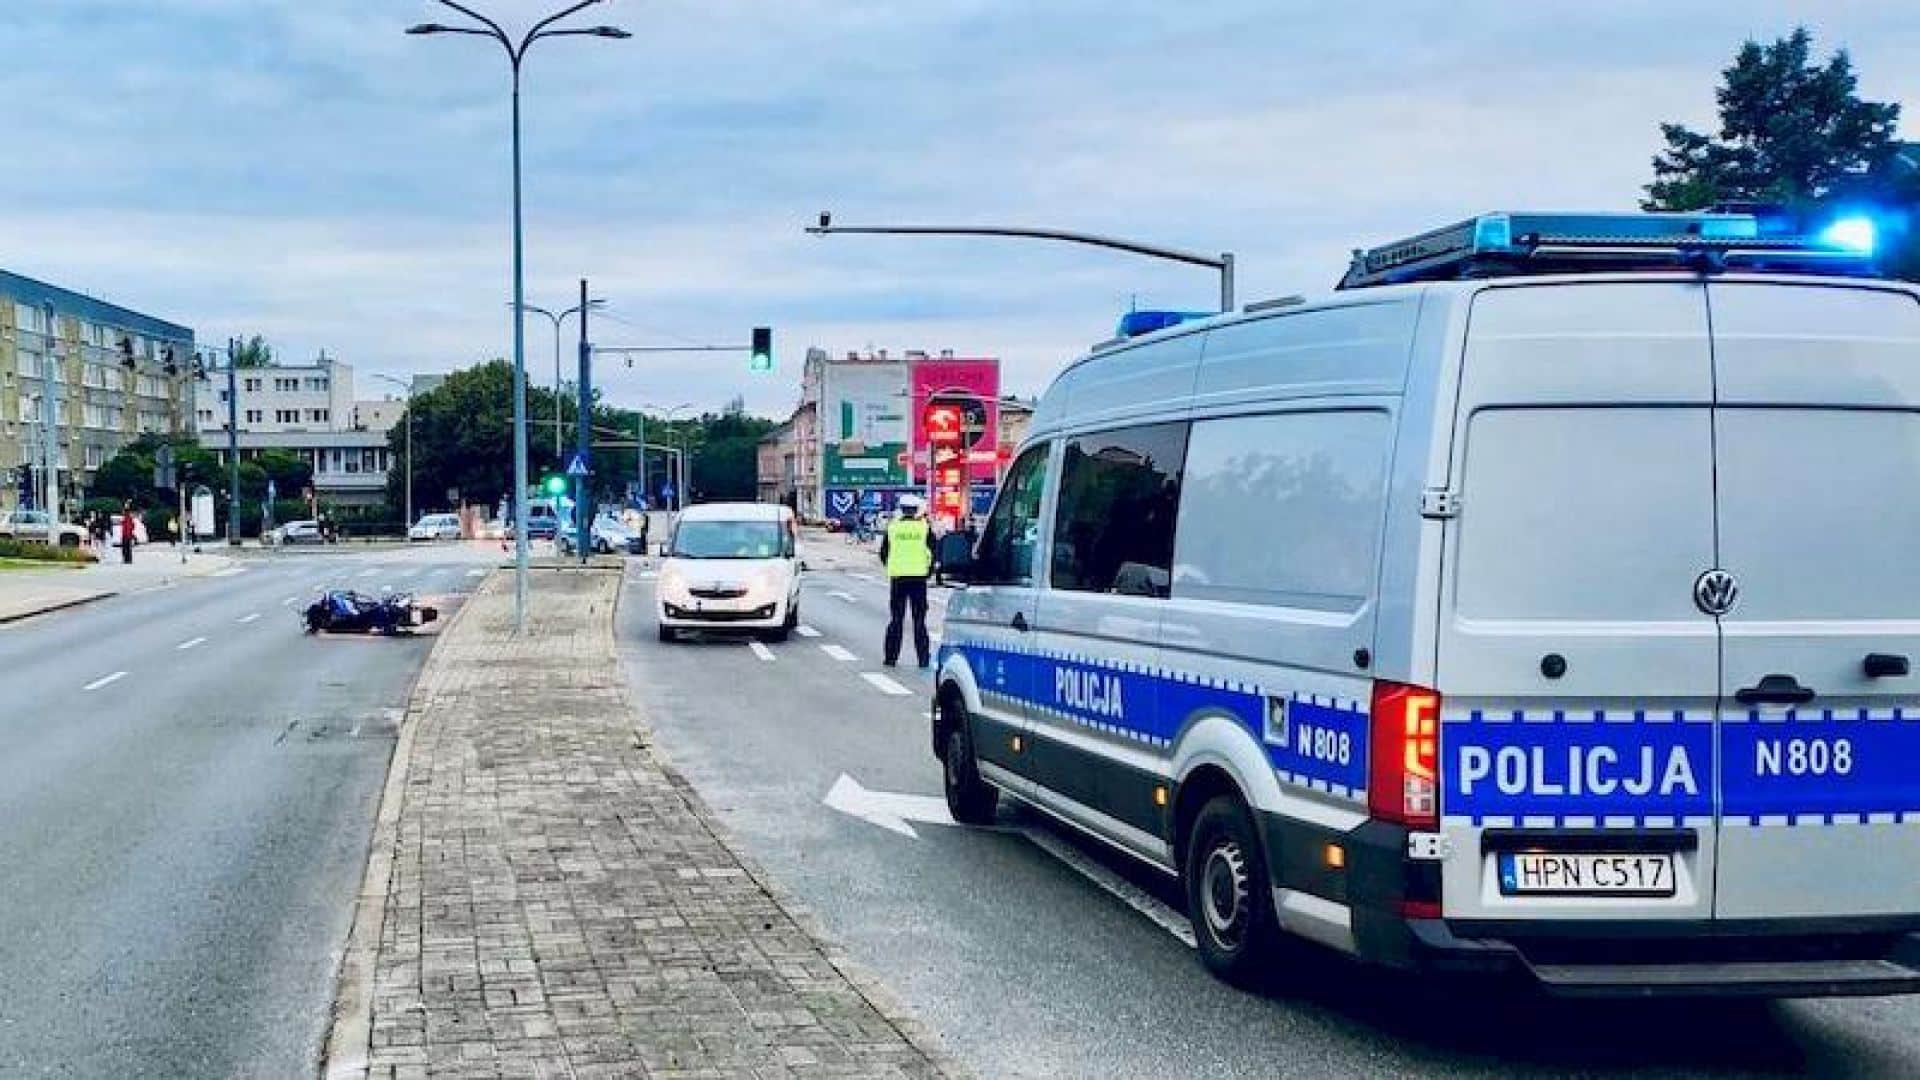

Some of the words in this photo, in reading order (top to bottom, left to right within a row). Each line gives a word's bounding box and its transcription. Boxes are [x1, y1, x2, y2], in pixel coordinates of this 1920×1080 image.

[1055, 667, 1123, 718] POLICJA
[1459, 746, 1698, 797] POLICJA
[1523, 858, 1581, 886] HPN
[1593, 858, 1665, 886] C517
